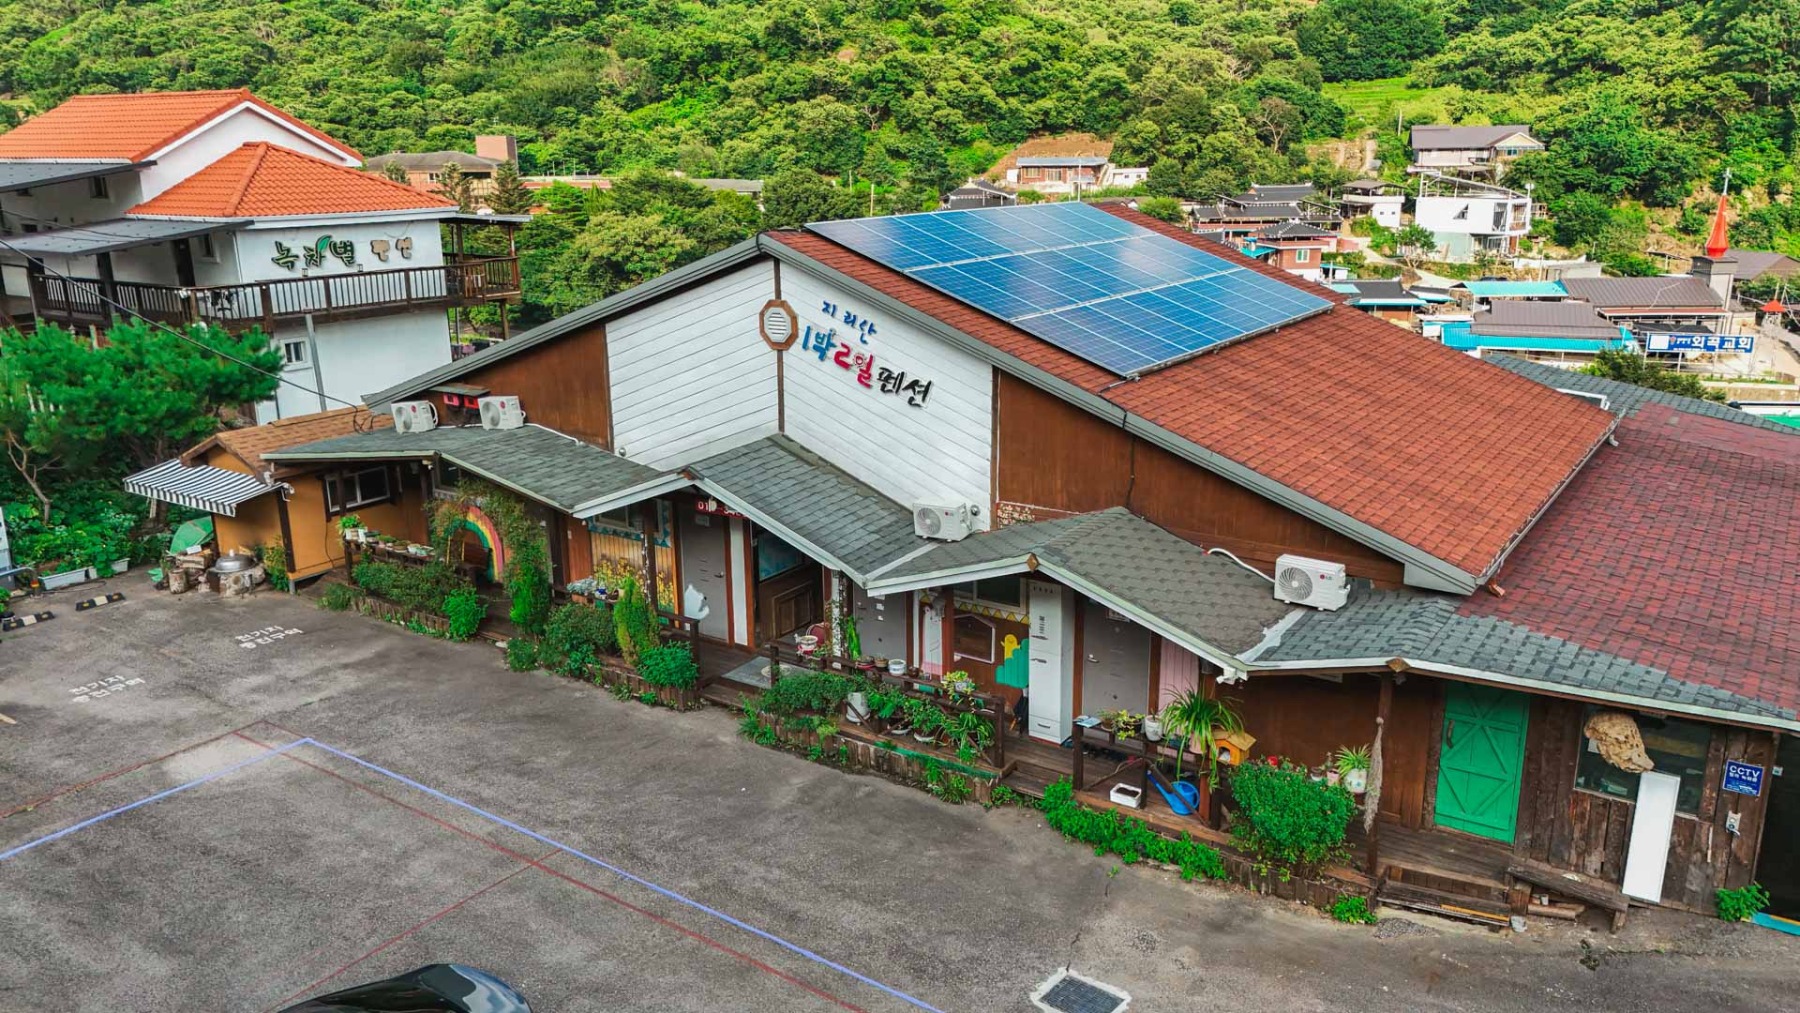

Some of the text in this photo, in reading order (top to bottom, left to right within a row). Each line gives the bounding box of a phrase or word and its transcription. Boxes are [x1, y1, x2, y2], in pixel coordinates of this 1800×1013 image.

[822, 301, 877, 345] 지리산
[1692, 335, 1752, 349] 외곡교회
[802, 325, 933, 407] 1박2일 펜션
[1729, 765, 1760, 778] CCTV
